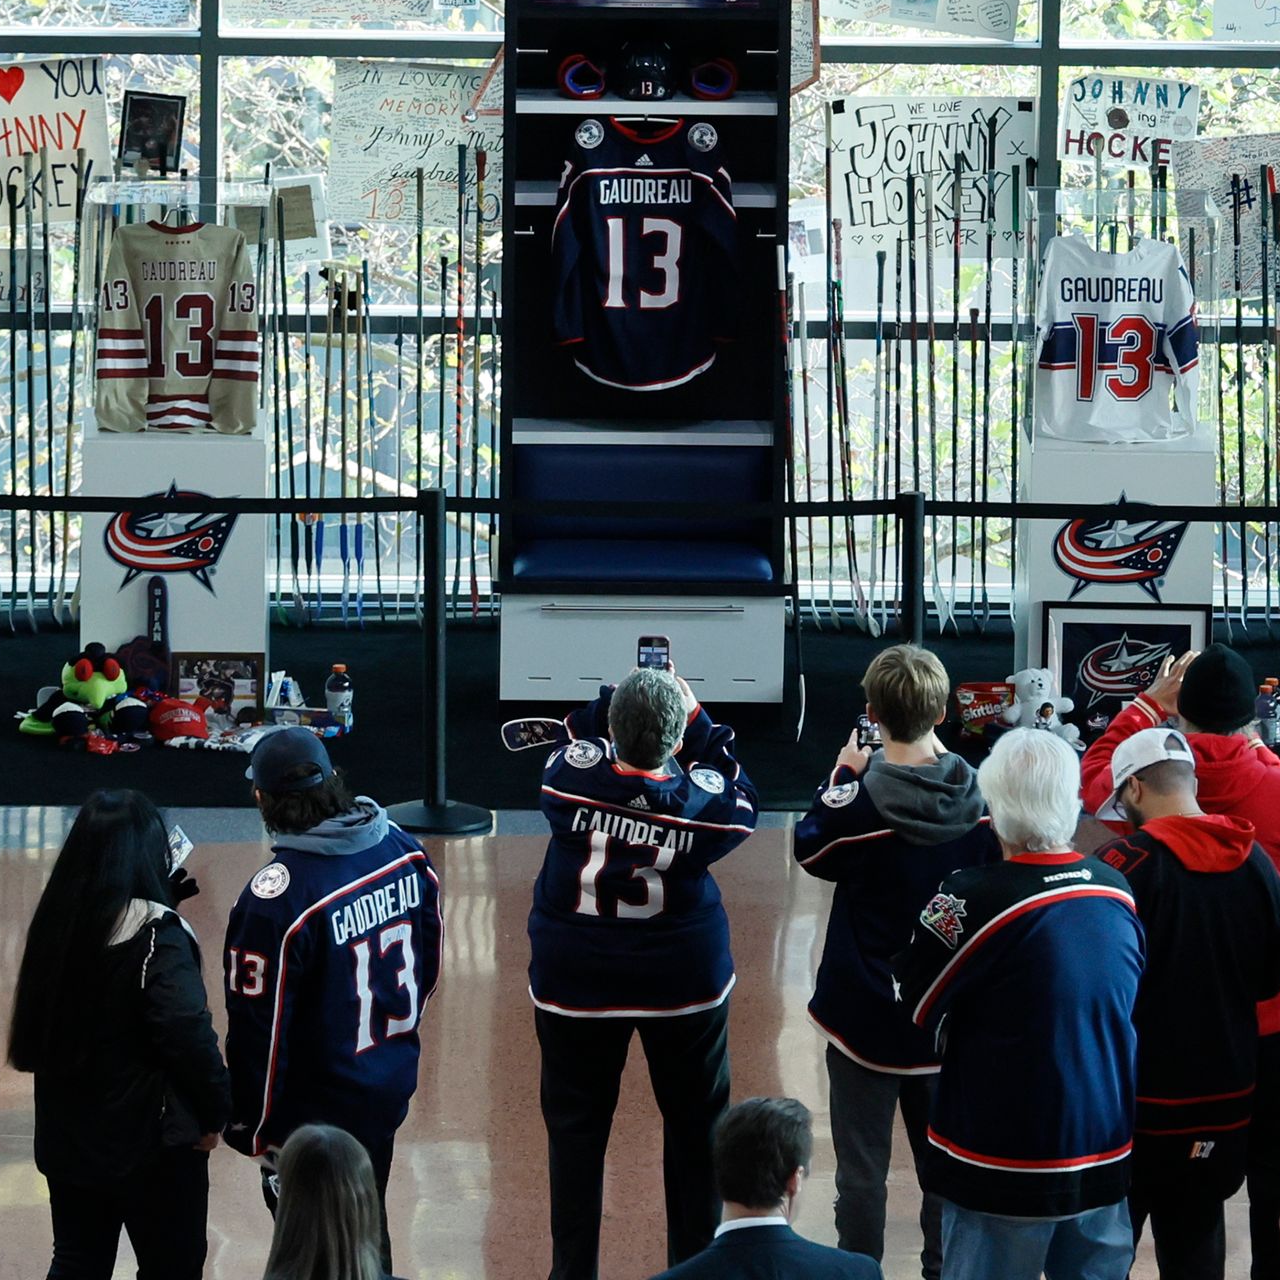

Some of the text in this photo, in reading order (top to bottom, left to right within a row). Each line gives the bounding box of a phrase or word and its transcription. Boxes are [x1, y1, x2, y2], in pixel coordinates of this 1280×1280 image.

[40, 59, 103, 100] YOU
[361, 70, 482, 91] IN LOVING
[640, 82, 653, 95] 13
[1071, 76, 1192, 109] JOHNNY
[379, 98, 460, 116] MEMORY
[906, 101, 962, 115] WE LOVE
[850, 104, 1013, 179] JOHNNY
[361, 188, 404, 220] 13
[599, 178, 692, 205] GAUDREAU
[844, 169, 1012, 228] HOCKEY
[141, 261, 216, 282] GAUDREAU
[604, 217, 682, 308] 13
[103, 279, 129, 311] 13
[228, 281, 255, 313] 13
[1060, 277, 1163, 304] GAUDREAU
[144, 292, 216, 379] 13
[1071, 313, 1159, 402] 13
[962, 702, 1009, 722] Skittles
[571, 807, 694, 854] GAUDREAU
[575, 830, 676, 920] 13
[331, 872, 421, 946] GAUDREAU
[228, 949, 266, 997] 13
[351, 922, 418, 1055] 13
